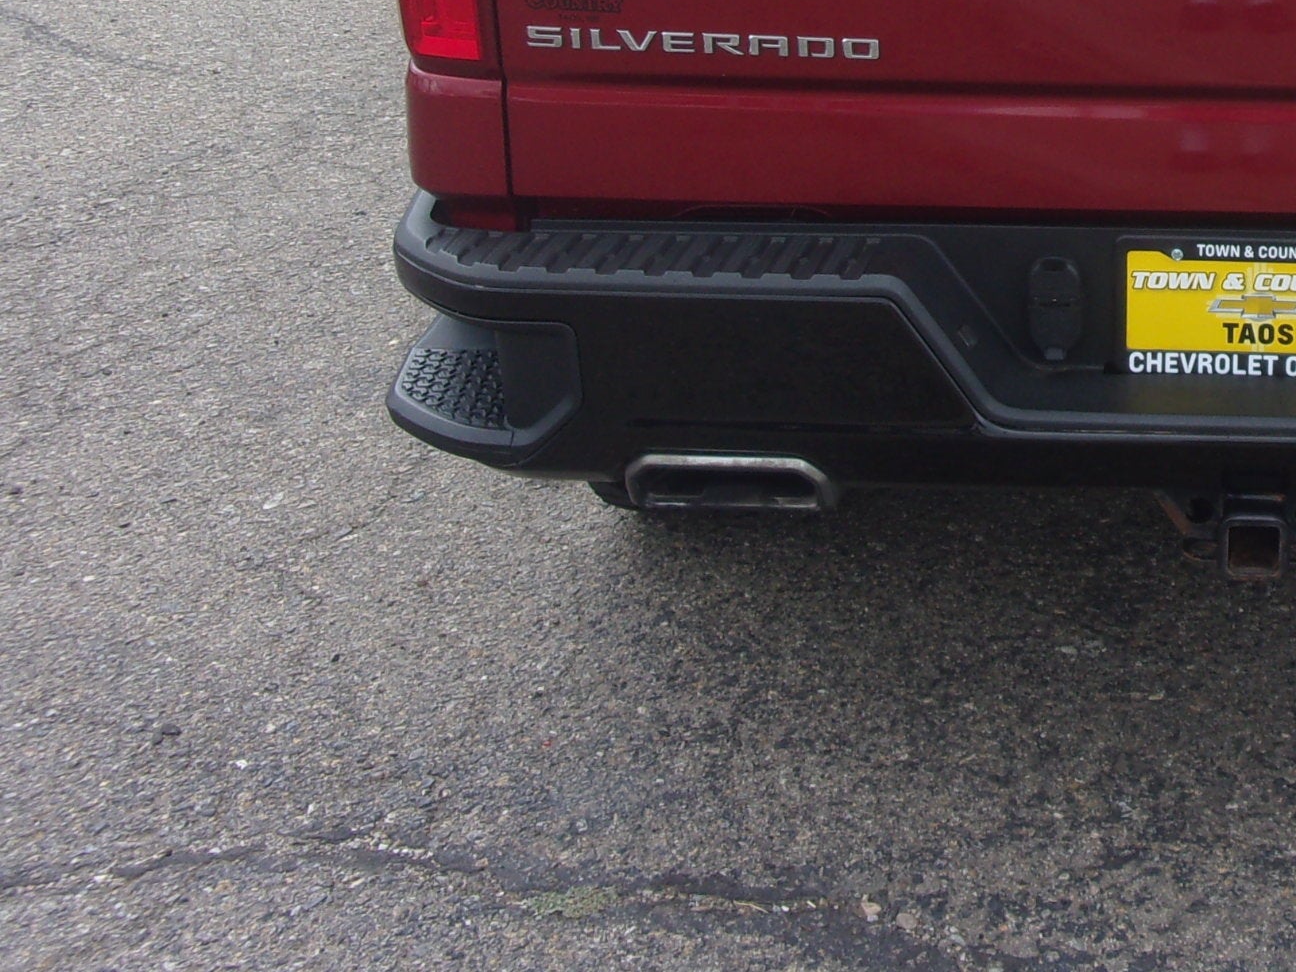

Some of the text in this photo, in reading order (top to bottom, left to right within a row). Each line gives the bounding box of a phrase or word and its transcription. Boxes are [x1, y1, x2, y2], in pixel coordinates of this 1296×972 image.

[526, 25, 880, 60] SILVERADO
[1197, 243, 1240, 258] TOWN
[1244, 245, 1254, 258] &
[1131, 271, 1216, 290] TOWN
[1222, 272, 1246, 291] &
[1223, 323, 1294, 345] TAOS
[1128, 352, 1279, 377] CHEVROLET
